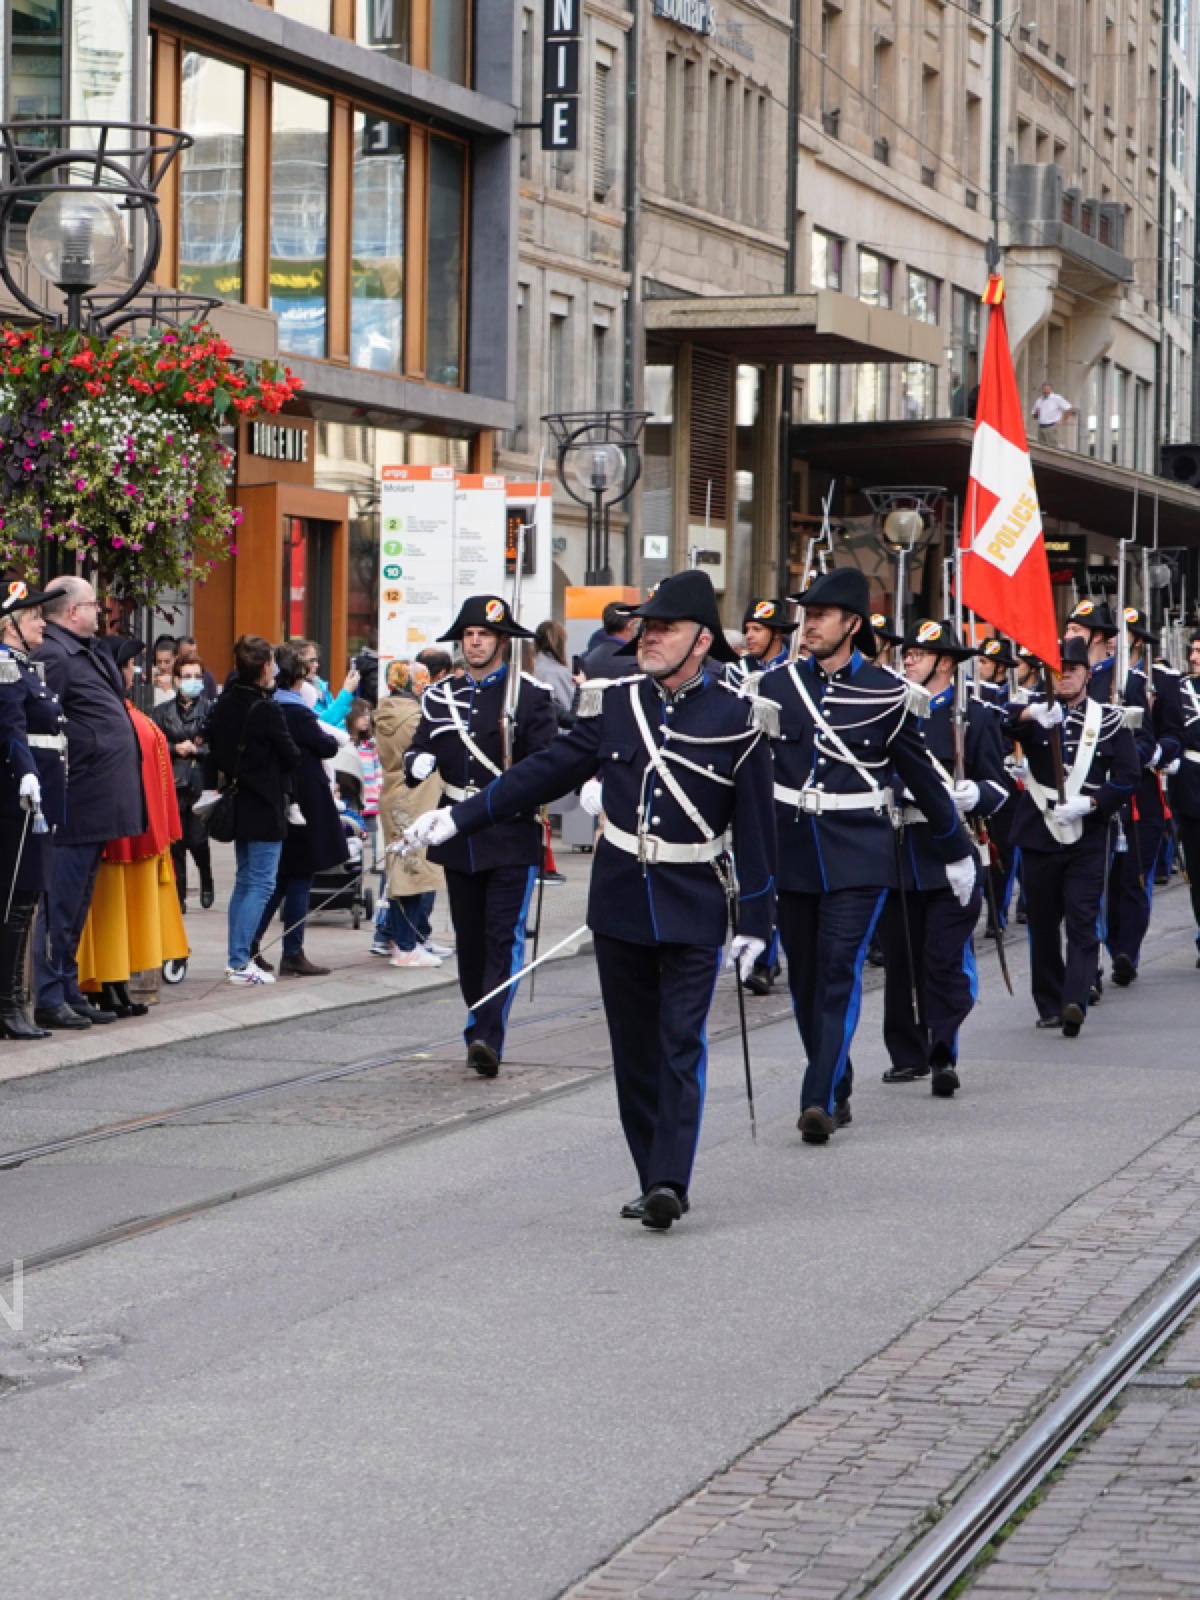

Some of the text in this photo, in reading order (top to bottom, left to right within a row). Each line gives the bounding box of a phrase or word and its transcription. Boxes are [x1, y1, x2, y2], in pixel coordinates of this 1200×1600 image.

[383, 483, 415, 493] Molard
[389, 519, 397, 529] 2
[987, 492, 1039, 562] POLICE
[389, 543, 397, 553] 7
[386, 567, 399, 577] 10
[386, 591, 399, 601] 12
